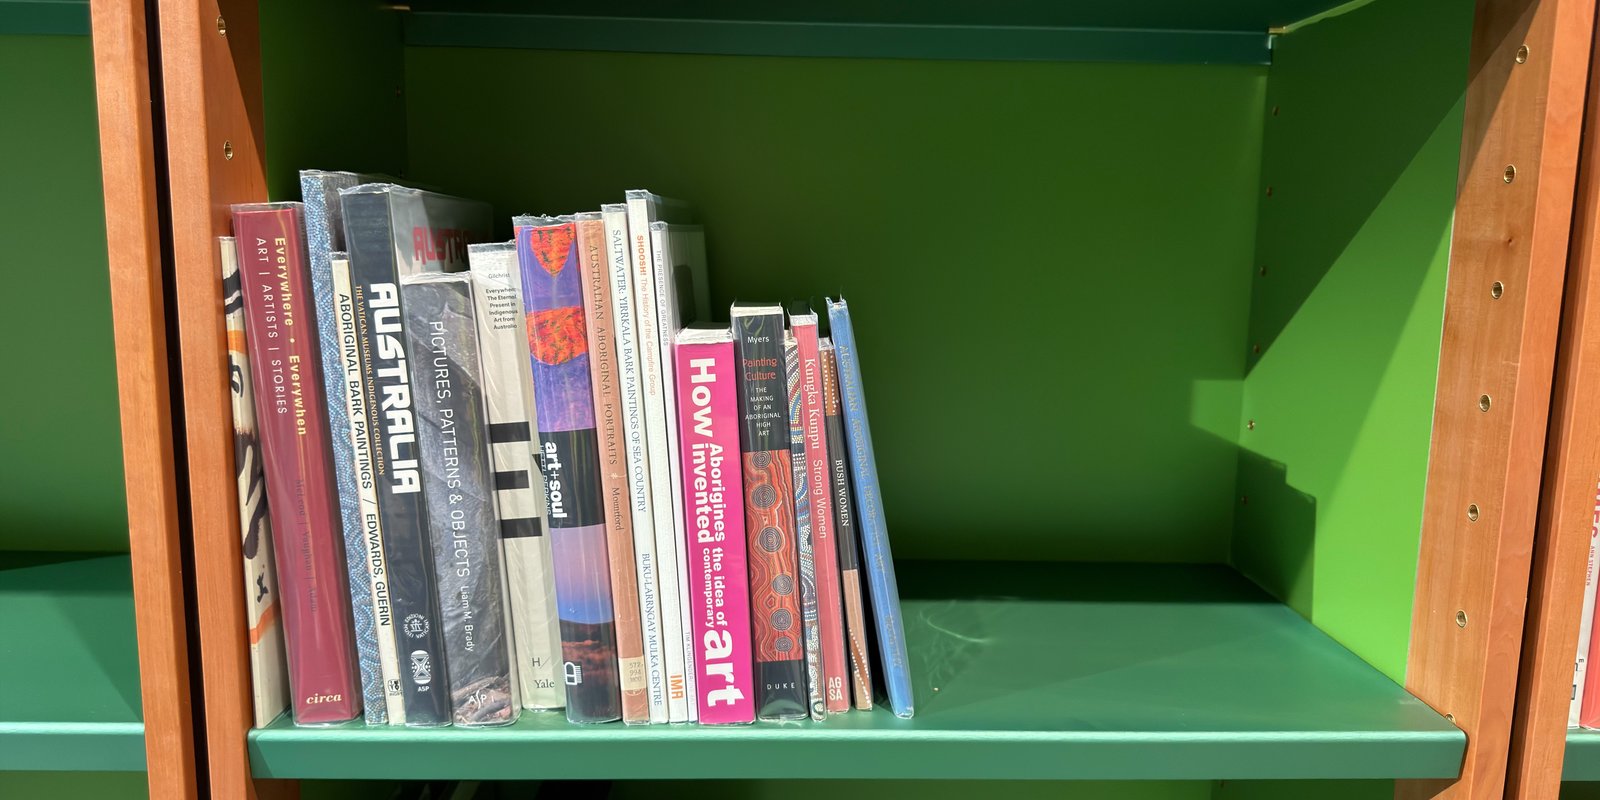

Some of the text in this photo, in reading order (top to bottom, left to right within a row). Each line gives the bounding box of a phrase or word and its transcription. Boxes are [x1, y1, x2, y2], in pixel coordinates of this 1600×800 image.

[256, 237, 269, 263] ART
[612, 229, 626, 294] SALTWATER:
[262, 284, 278, 339] ARTISTS
[358, 301, 367, 335] VATICAN
[620, 296, 630, 346] YIRRKALA
[636, 235, 656, 396] SHOOSH! The History of the Campfire Group
[660, 298, 666, 308] OF
[274, 237, 306, 435] Everywhere Everywhen
[339, 293, 357, 376] ABORIGINAL
[661, 310, 669, 346] GREATNESS
[748, 336, 770, 344] Myers
[362, 336, 373, 375] MUSEUMS
[429, 321, 452, 404] PICTURES,
[624, 348, 634, 374] BARK
[742, 357, 777, 368] Painting
[745, 371, 776, 382] Culture
[271, 359, 287, 414] STORIES
[350, 381, 363, 416] BARK
[367, 376, 379, 426] INDIGENOUS
[368, 282, 422, 494] AUSTRALIA
[589, 245, 624, 531] AUSTRALIAN ABORIGINAL PORTRAITS Mountford
[626, 376, 640, 430] PAINTINGS
[689, 357, 717, 438] How
[803, 358, 818, 406] Kungka
[632, 432, 640, 444] OF
[745, 412, 780, 420] ABORIGINAL
[354, 421, 373, 489] PAINTINGS
[373, 428, 385, 476] COLLECTION
[440, 408, 461, 489] PATTERNS
[632, 446, 643, 464] SEA
[450, 493, 463, 504] &
[545, 442, 568, 518] art+soul
[634, 466, 647, 512] COUNTRY
[692, 443, 714, 544] invented
[708, 442, 726, 542] Aborigines
[812, 459, 823, 496] Strong
[835, 459, 850, 527] BUSH WOMEN
[816, 497, 827, 539] Women
[366, 513, 385, 579] EDWARDS,
[450, 510, 470, 578] OBJECTS
[376, 582, 390, 626] GUERIN
[460, 585, 471, 610] Liam
[702, 547, 714, 628] contemporary
[712, 547, 728, 627] the idea of
[464, 624, 474, 652] Brady
[648, 634, 658, 668] MULKA
[534, 679, 555, 688] Yale
[652, 669, 662, 705] CENTRE
[670, 674, 684, 699] IMA
[703, 629, 745, 708] art
[766, 682, 796, 690] DUKE
[828, 676, 842, 689] AG
[306, 692, 342, 705] circa
[828, 688, 843, 700] SA
